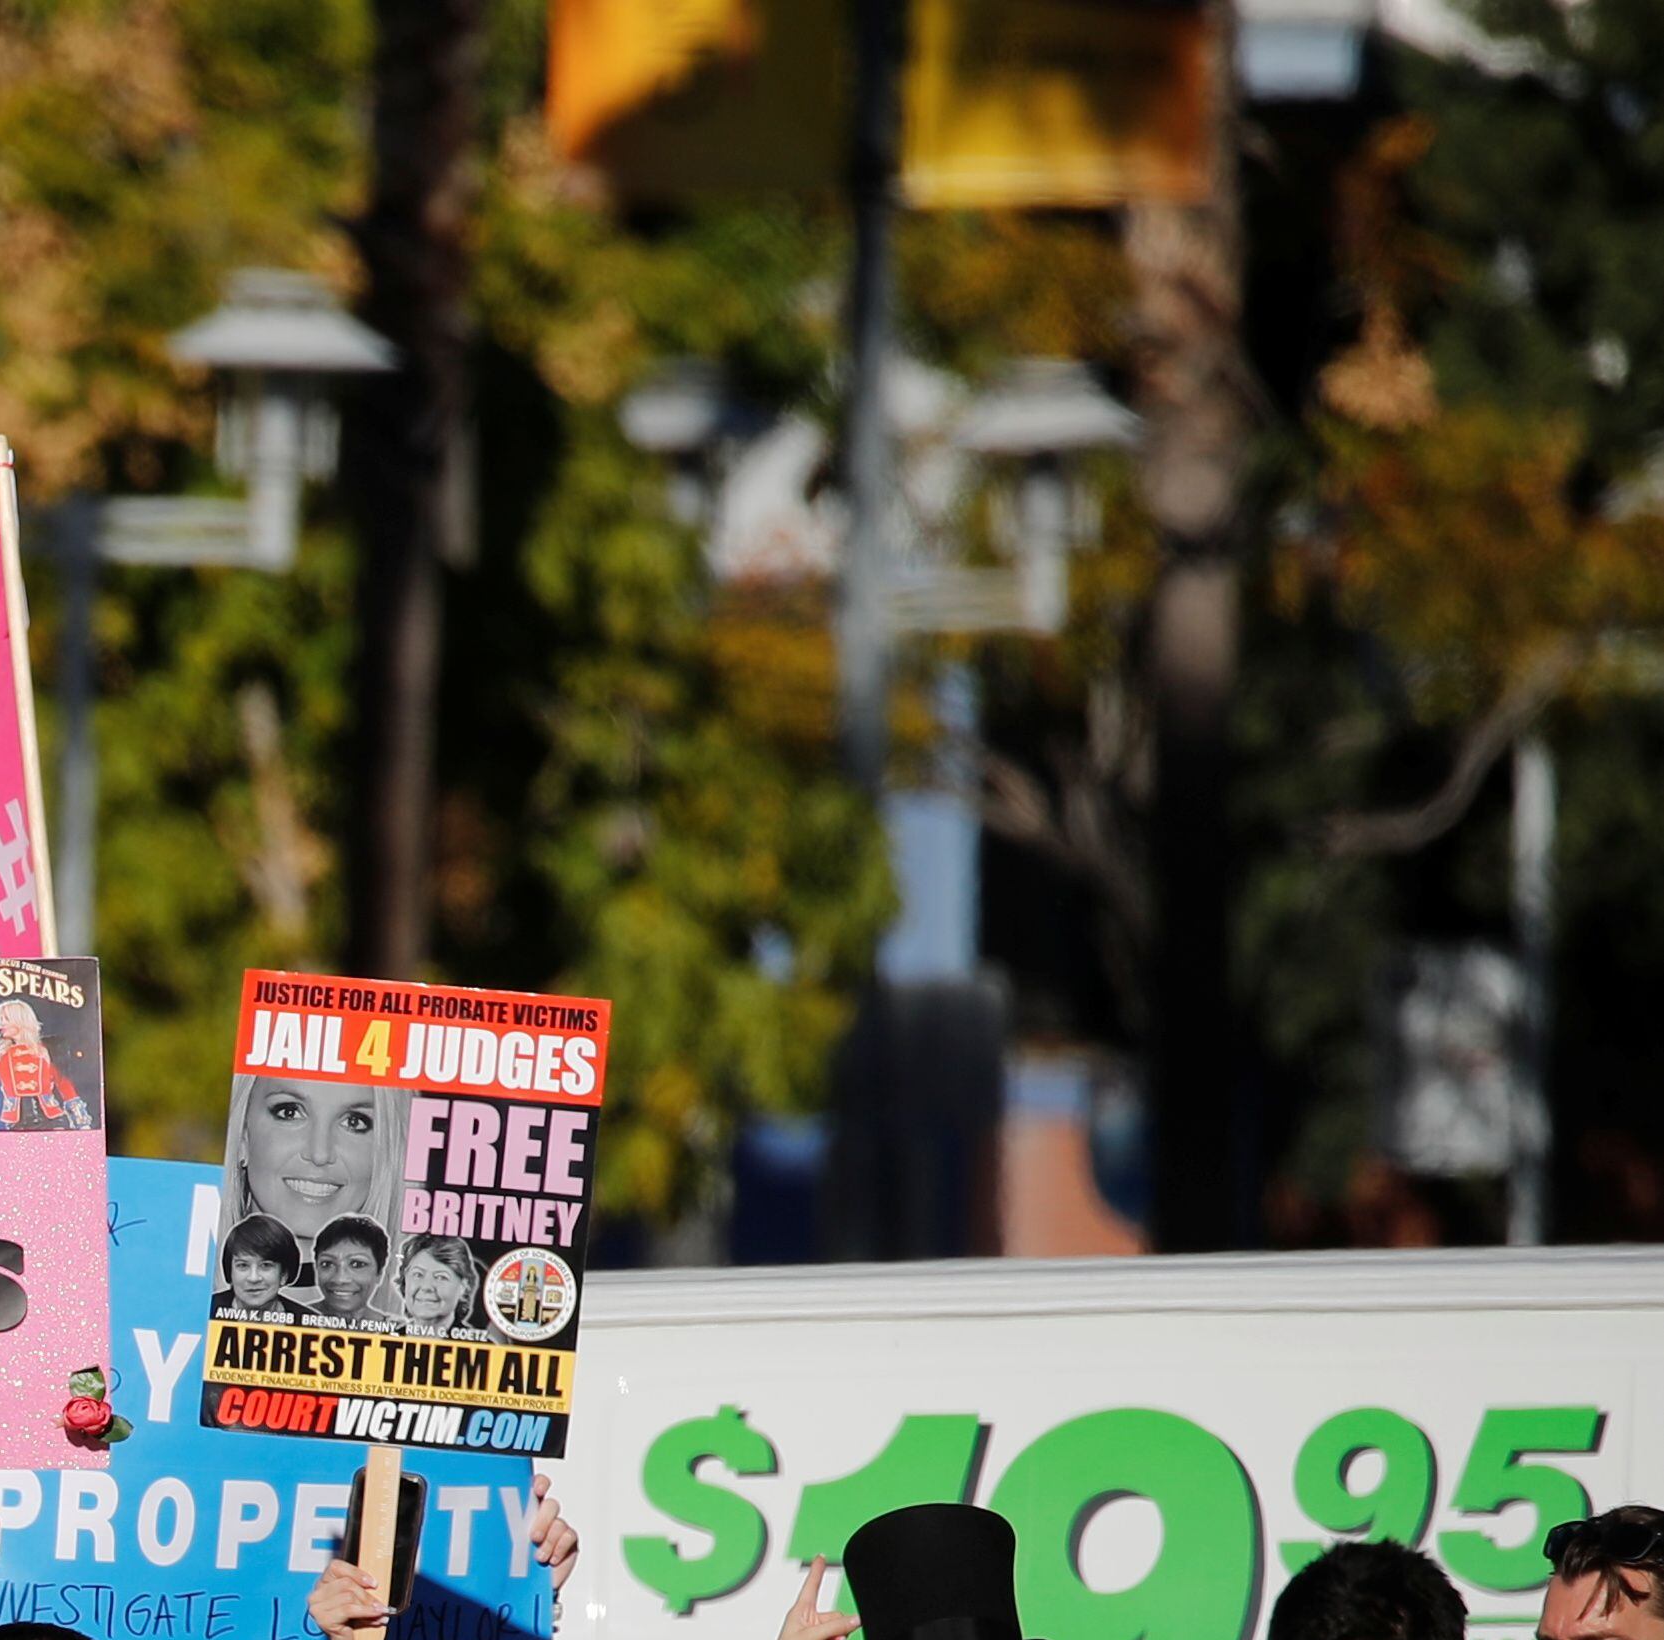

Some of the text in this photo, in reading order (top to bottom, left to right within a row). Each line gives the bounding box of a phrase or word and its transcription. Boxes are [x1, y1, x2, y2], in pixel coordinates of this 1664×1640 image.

[253, 980, 599, 1033] JUSTICE FOR ALL PROBATE VICTIMS
[244, 1008, 597, 1097] JAIL 4 JUDGES
[403, 1096, 590, 1198] FREE
[400, 1186, 584, 1248] BRITNEY
[215, 1307, 295, 1325] AVIVA K. BOBB
[301, 1314, 398, 1334] BRENDA J. PENNY
[406, 1323, 489, 1342] REVA G. GOETZ
[209, 1369, 554, 1411] EVIDENCE, FINANCIALS, WITNESS STATEMENTS & DOCUMENTATION PROVE
[213, 1326, 372, 1381] ARREST
[380, 1338, 492, 1392] THEM
[498, 1351, 564, 1398] ALL
[216, 1387, 550, 1453] COURTVICTIM.COM
